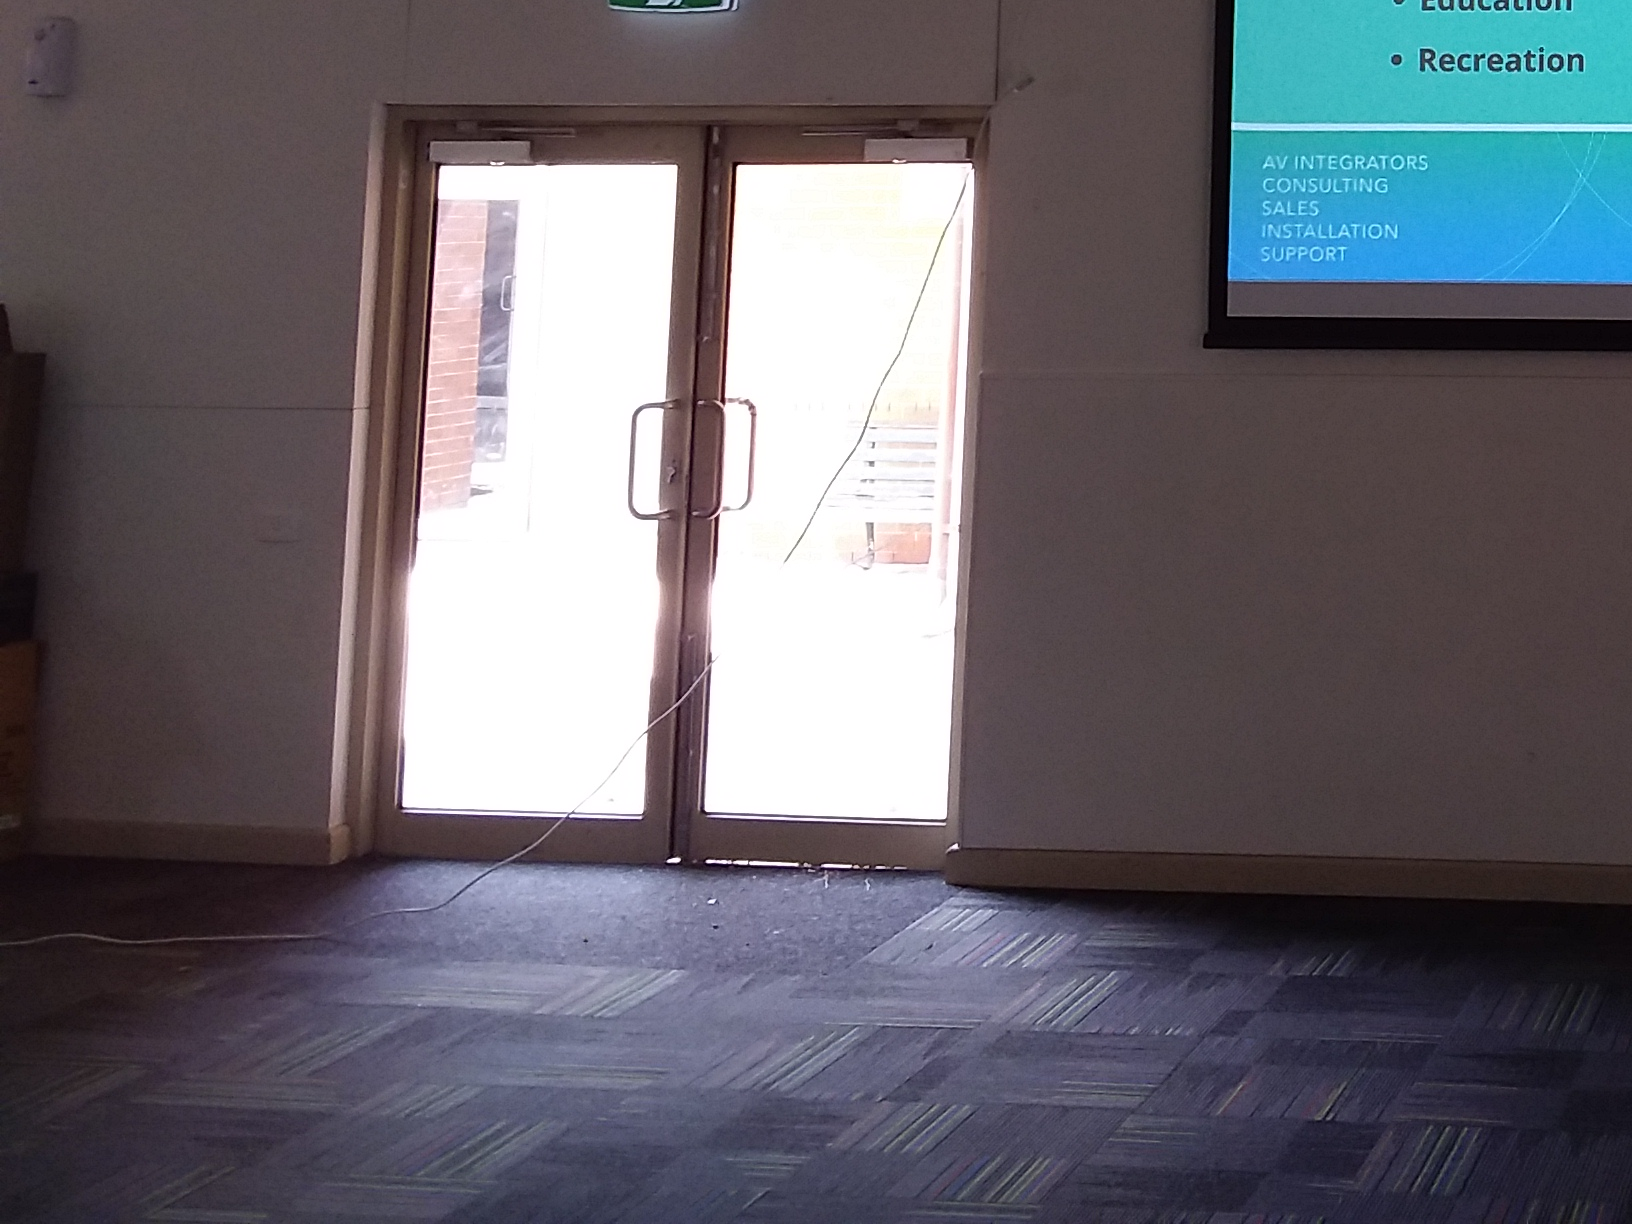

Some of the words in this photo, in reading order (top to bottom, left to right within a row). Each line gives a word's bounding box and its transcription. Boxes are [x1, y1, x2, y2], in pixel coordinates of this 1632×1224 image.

[1419, 46, 1584, 73] Recreation
[1262, 155, 1289, 170] AV
[1294, 154, 1429, 171] INTEGRATORS
[1262, 177, 1389, 194] CONSULTING
[1262, 200, 1320, 217] SALES
[1261, 223, 1399, 240] INSTALLATION
[1260, 245, 1348, 263] SUPPORT
